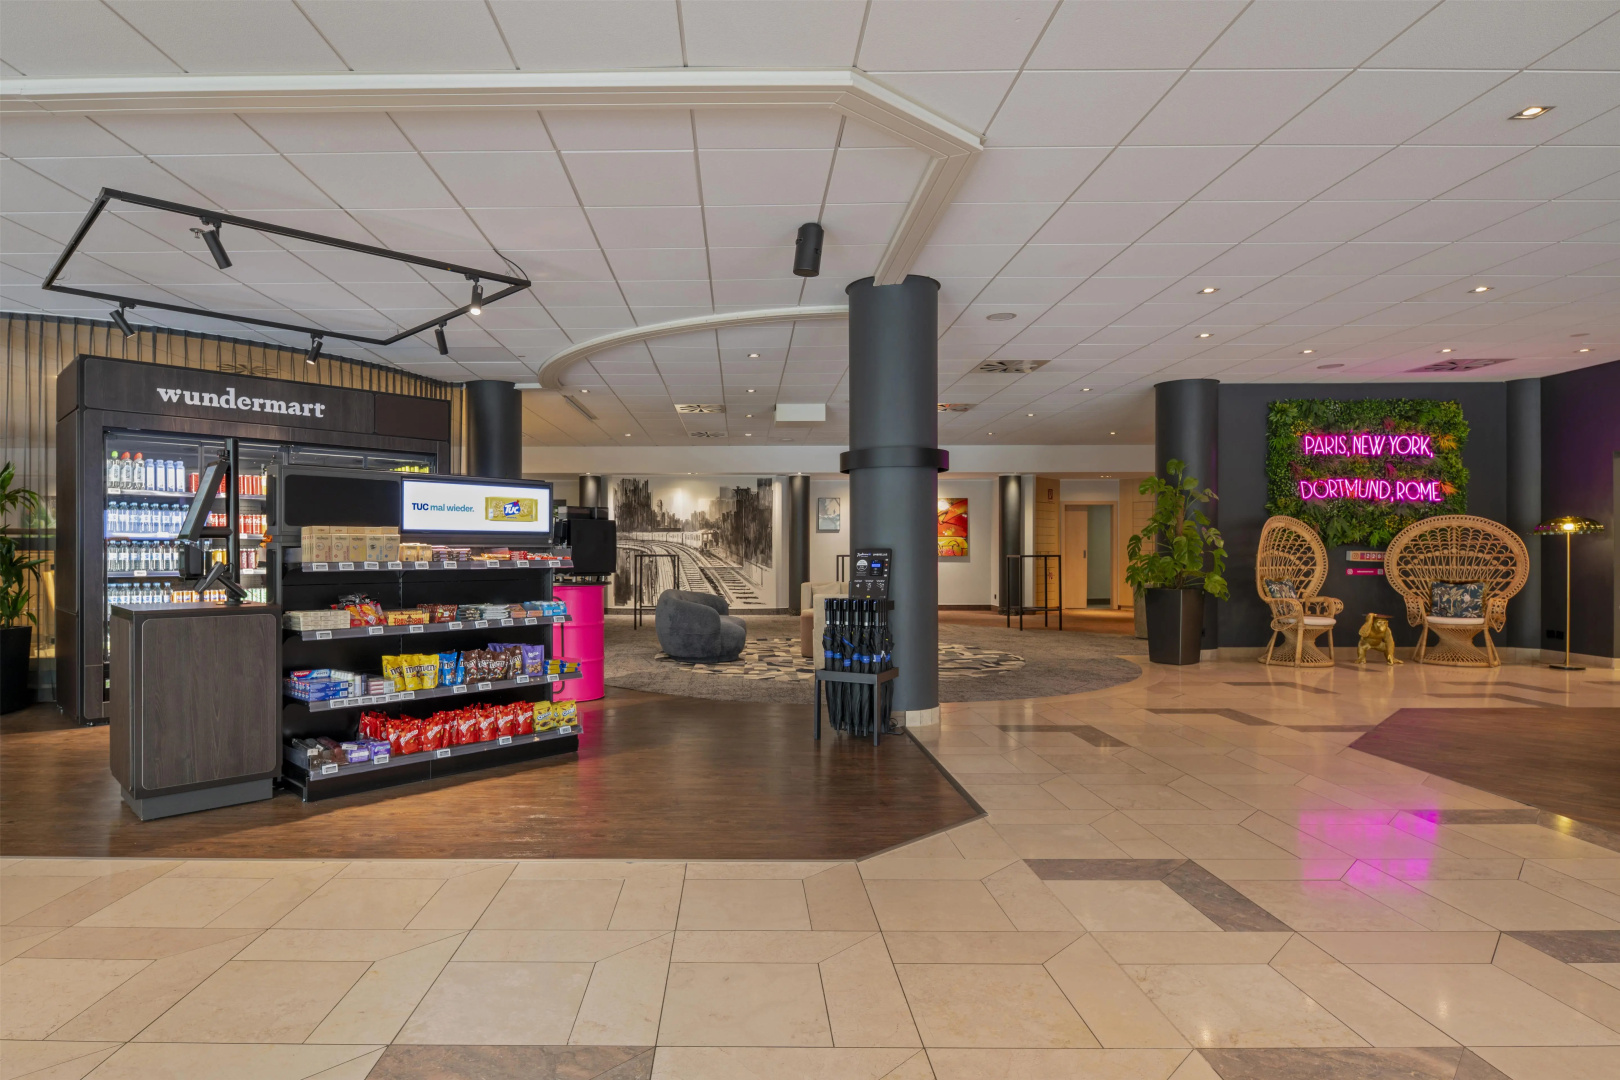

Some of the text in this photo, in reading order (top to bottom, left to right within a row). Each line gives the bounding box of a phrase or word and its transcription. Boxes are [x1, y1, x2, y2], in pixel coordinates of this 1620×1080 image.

[156, 387, 326, 418] wundermart
[1304, 435, 1434, 458] PARIS, NEW YORK,
[1299, 479, 1442, 502] DORTMUND, ROME
[411, 503, 475, 512] TUC mal wieder.
[504, 504, 520, 514] TUC
